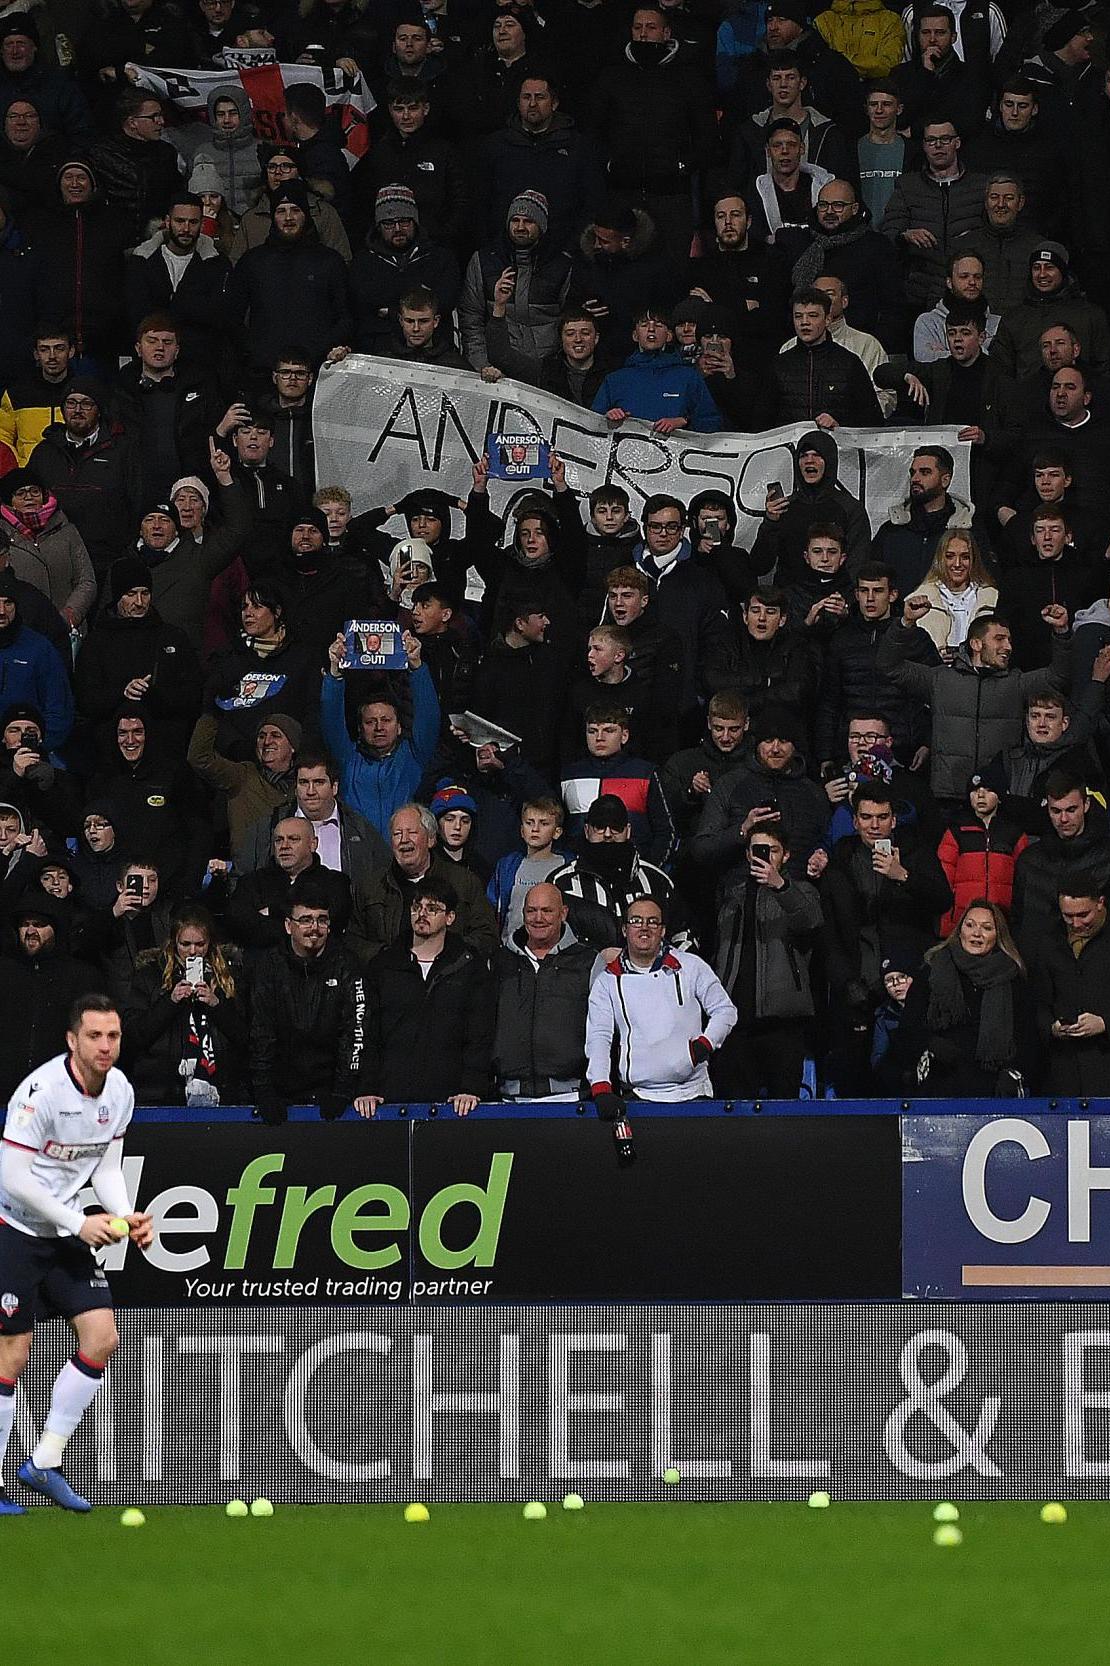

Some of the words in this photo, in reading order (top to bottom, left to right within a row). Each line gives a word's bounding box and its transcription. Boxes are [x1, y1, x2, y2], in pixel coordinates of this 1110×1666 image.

[348, 621, 400, 633] ANDERSON
[243, 674, 280, 682] DERSON
[355, 978, 365, 1002] THE
[185, 1278, 236, 1299] Your
[242, 1279, 318, 1297] trusted
[326, 1277, 402, 1300] trading
[410, 1280, 493, 1300] partner
[884, 1328, 1003, 1481] &
